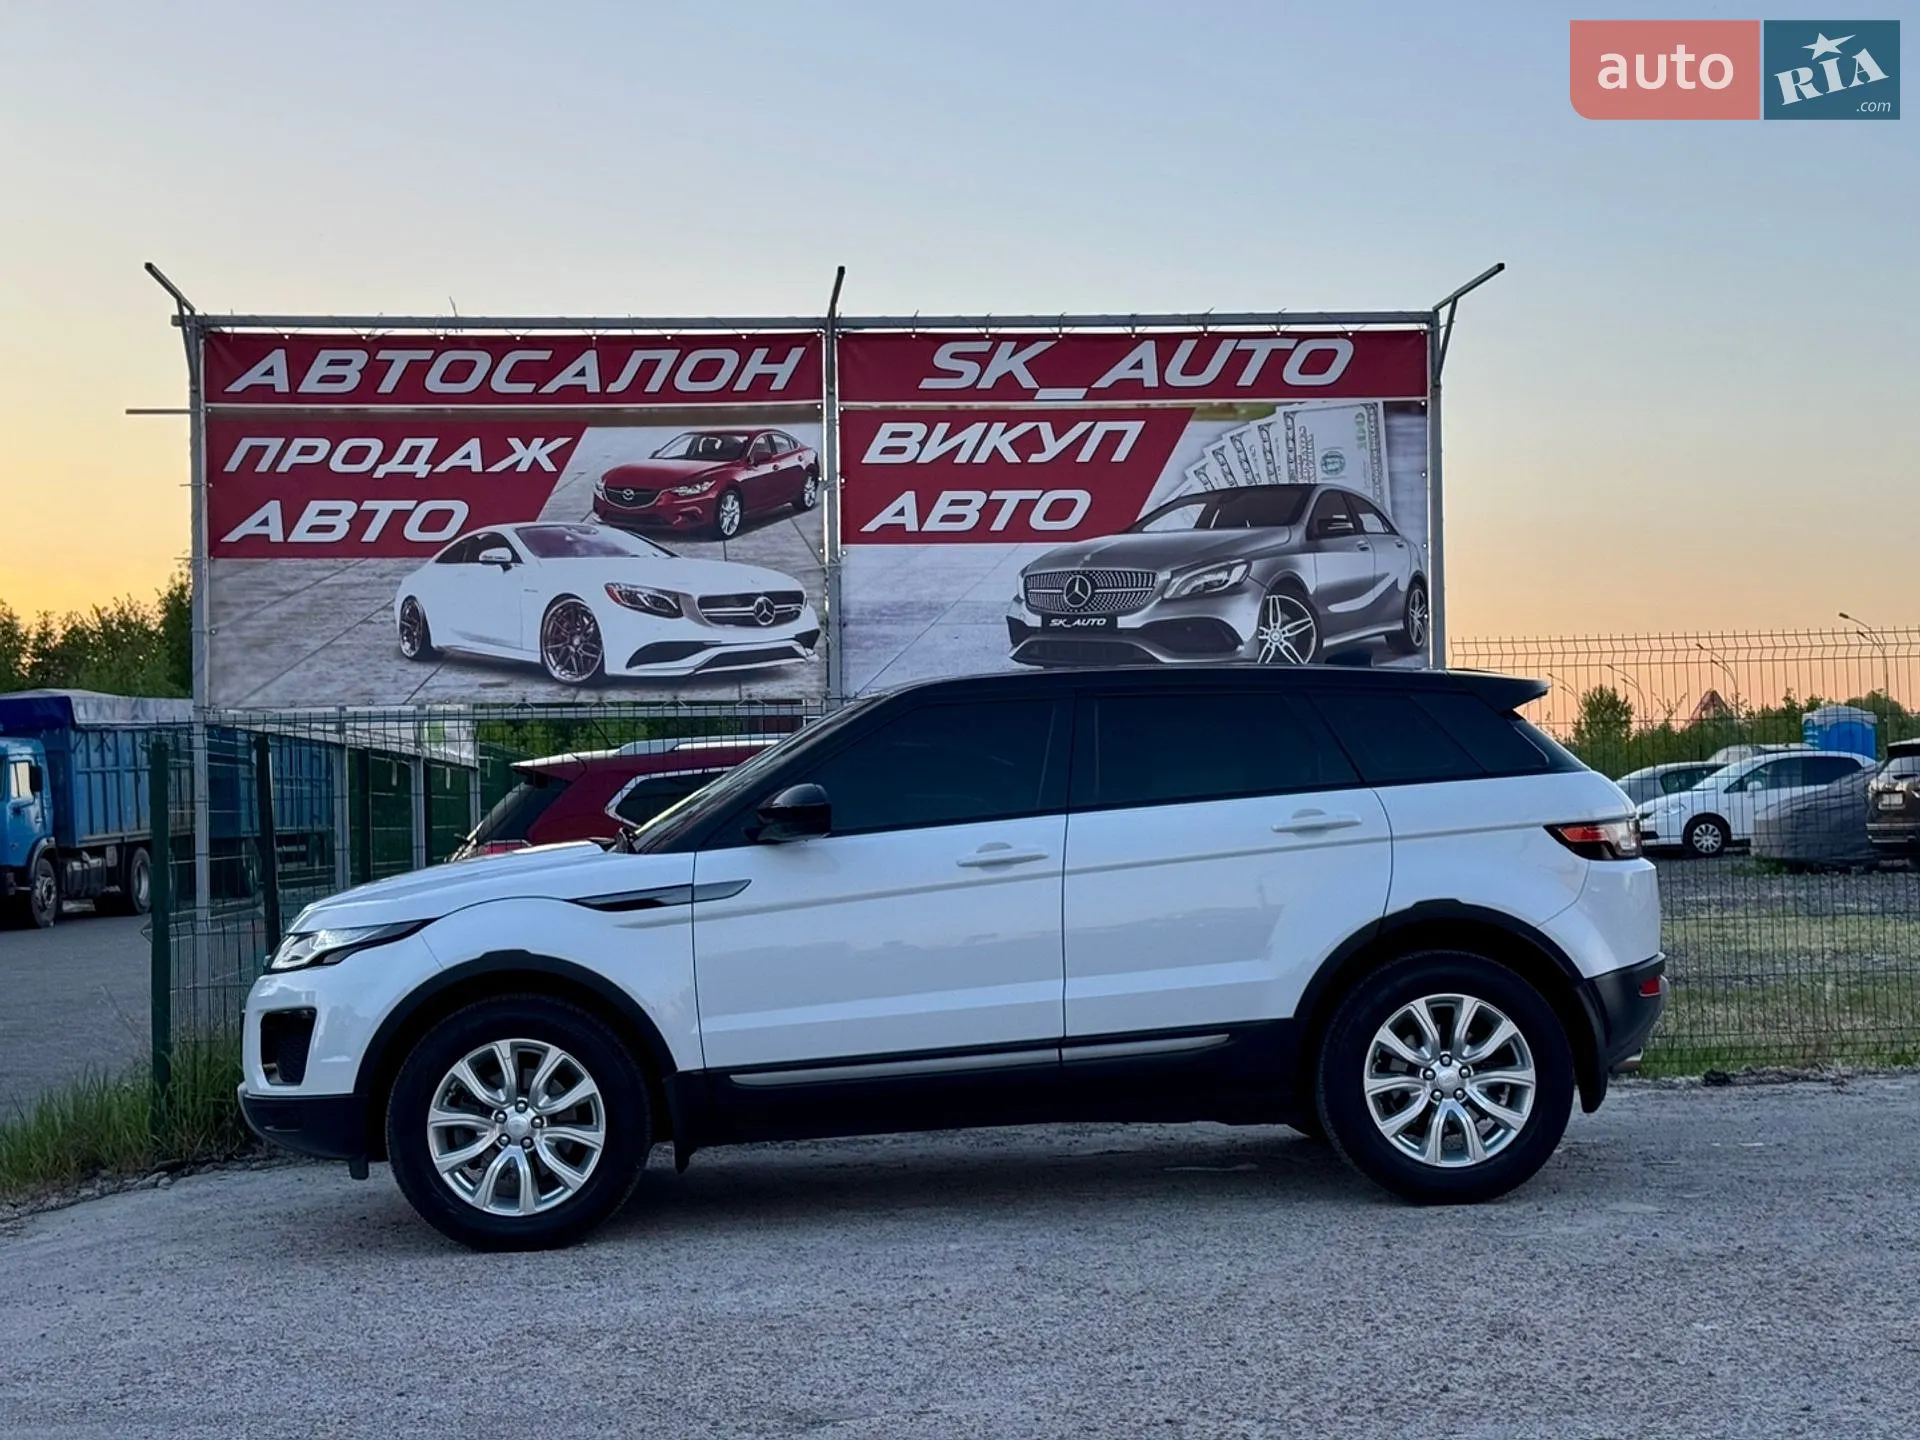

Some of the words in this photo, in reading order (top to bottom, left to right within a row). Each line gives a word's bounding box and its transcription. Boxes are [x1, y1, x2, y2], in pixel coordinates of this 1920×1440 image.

[223, 346, 807, 394] АВТОСАЛОН
[917, 337, 1355, 401] SK_AUTO
[223, 436, 574, 479] ПРОДАЖ
[860, 420, 1147, 464] ВИКУП
[220, 499, 470, 543] АВТО
[860, 489, 1091, 532] АВТО
[1049, 618, 1107, 628] SK_AUTO
